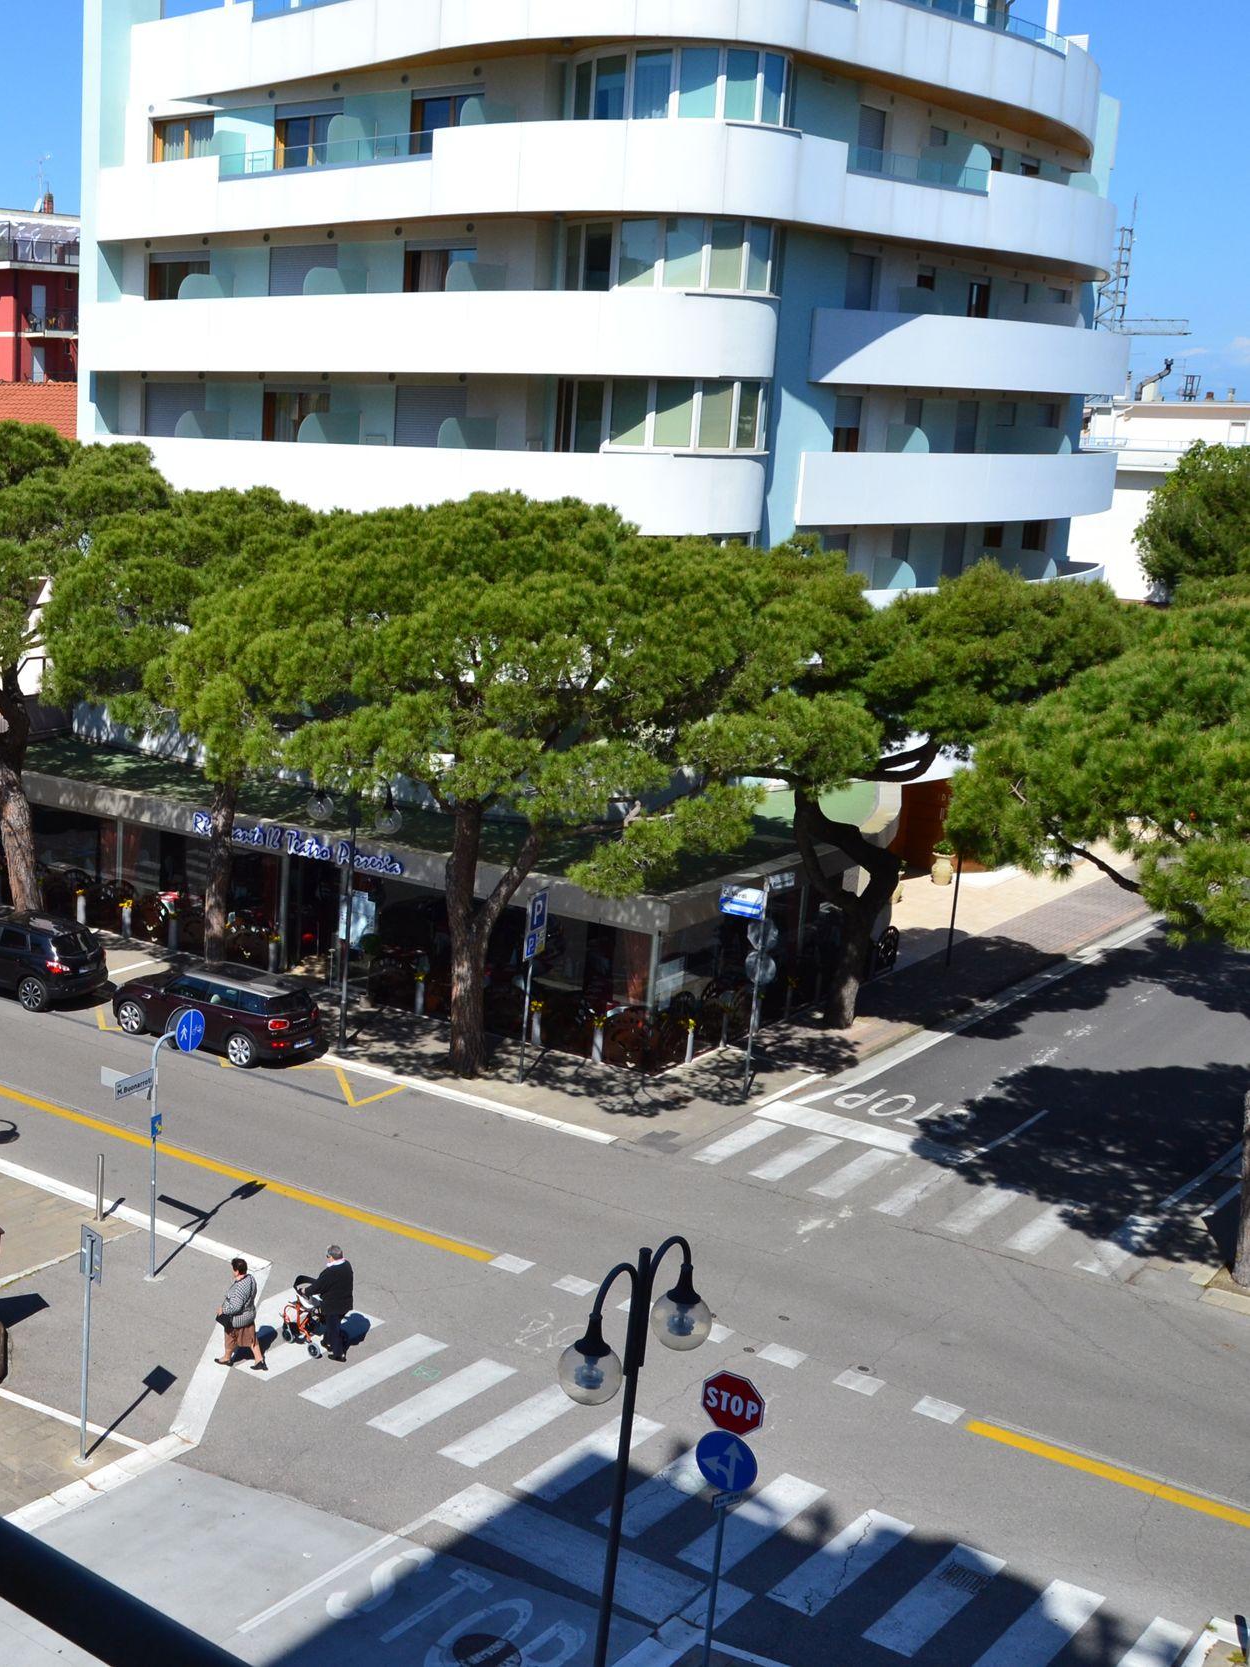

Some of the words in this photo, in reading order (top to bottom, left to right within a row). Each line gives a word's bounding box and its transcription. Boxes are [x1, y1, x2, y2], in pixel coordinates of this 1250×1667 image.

[285, 829, 331, 861] Teatro
[534, 900, 543, 925] P
[706, 1386, 760, 1421] STOP
[325, 1547, 588, 1667] STOP
